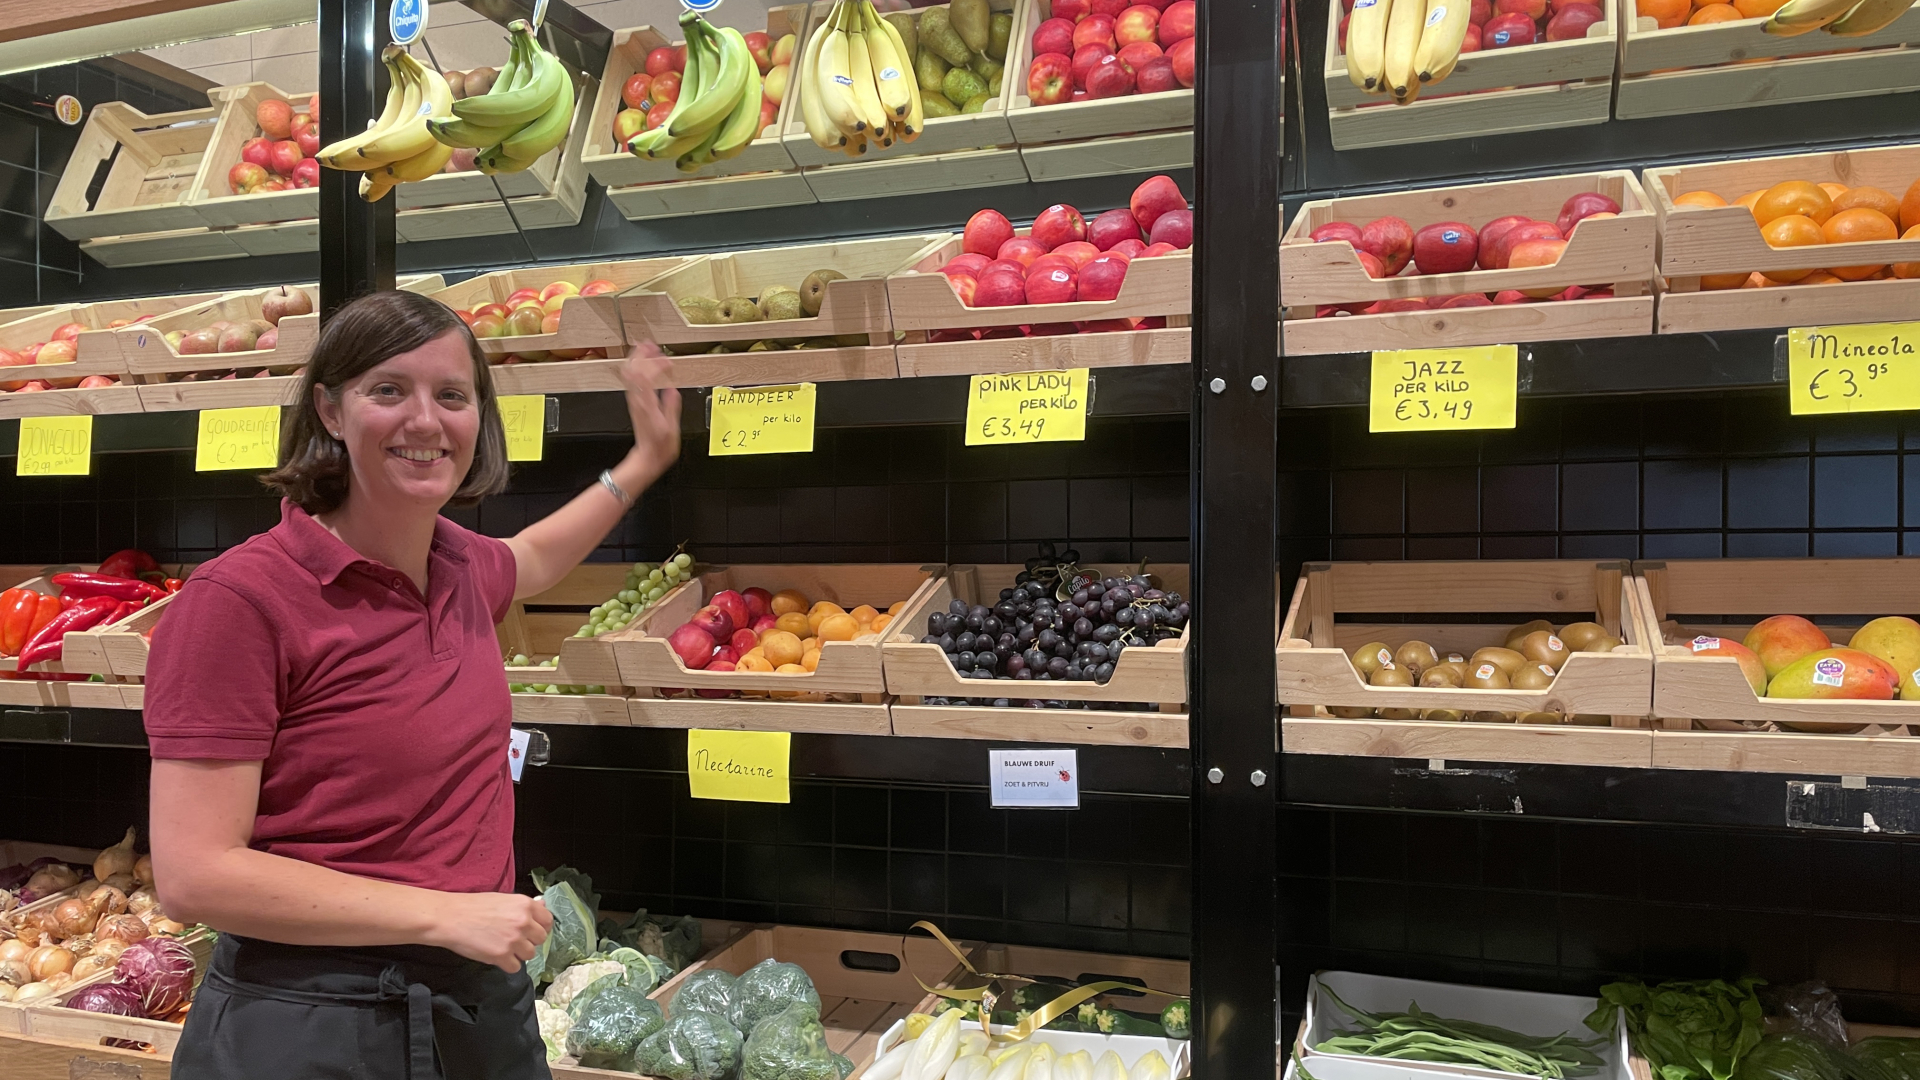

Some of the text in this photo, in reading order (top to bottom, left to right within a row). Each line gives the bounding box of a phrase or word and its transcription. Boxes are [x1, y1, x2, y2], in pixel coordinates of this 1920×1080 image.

[396, 13, 419, 26] Chiquita
[1808, 334, 1915, 359] Mineola
[1402, 360, 1465, 381] JAZZ
[718, 390, 794, 406] HANDPEER
[1394, 382, 1426, 398] PER
[763, 414, 802, 426] per kilo
[21, 427, 89, 458] JONAGOLD
[1067, 577, 1090, 595] Capilo
[695, 749, 774, 778] Nectarine
